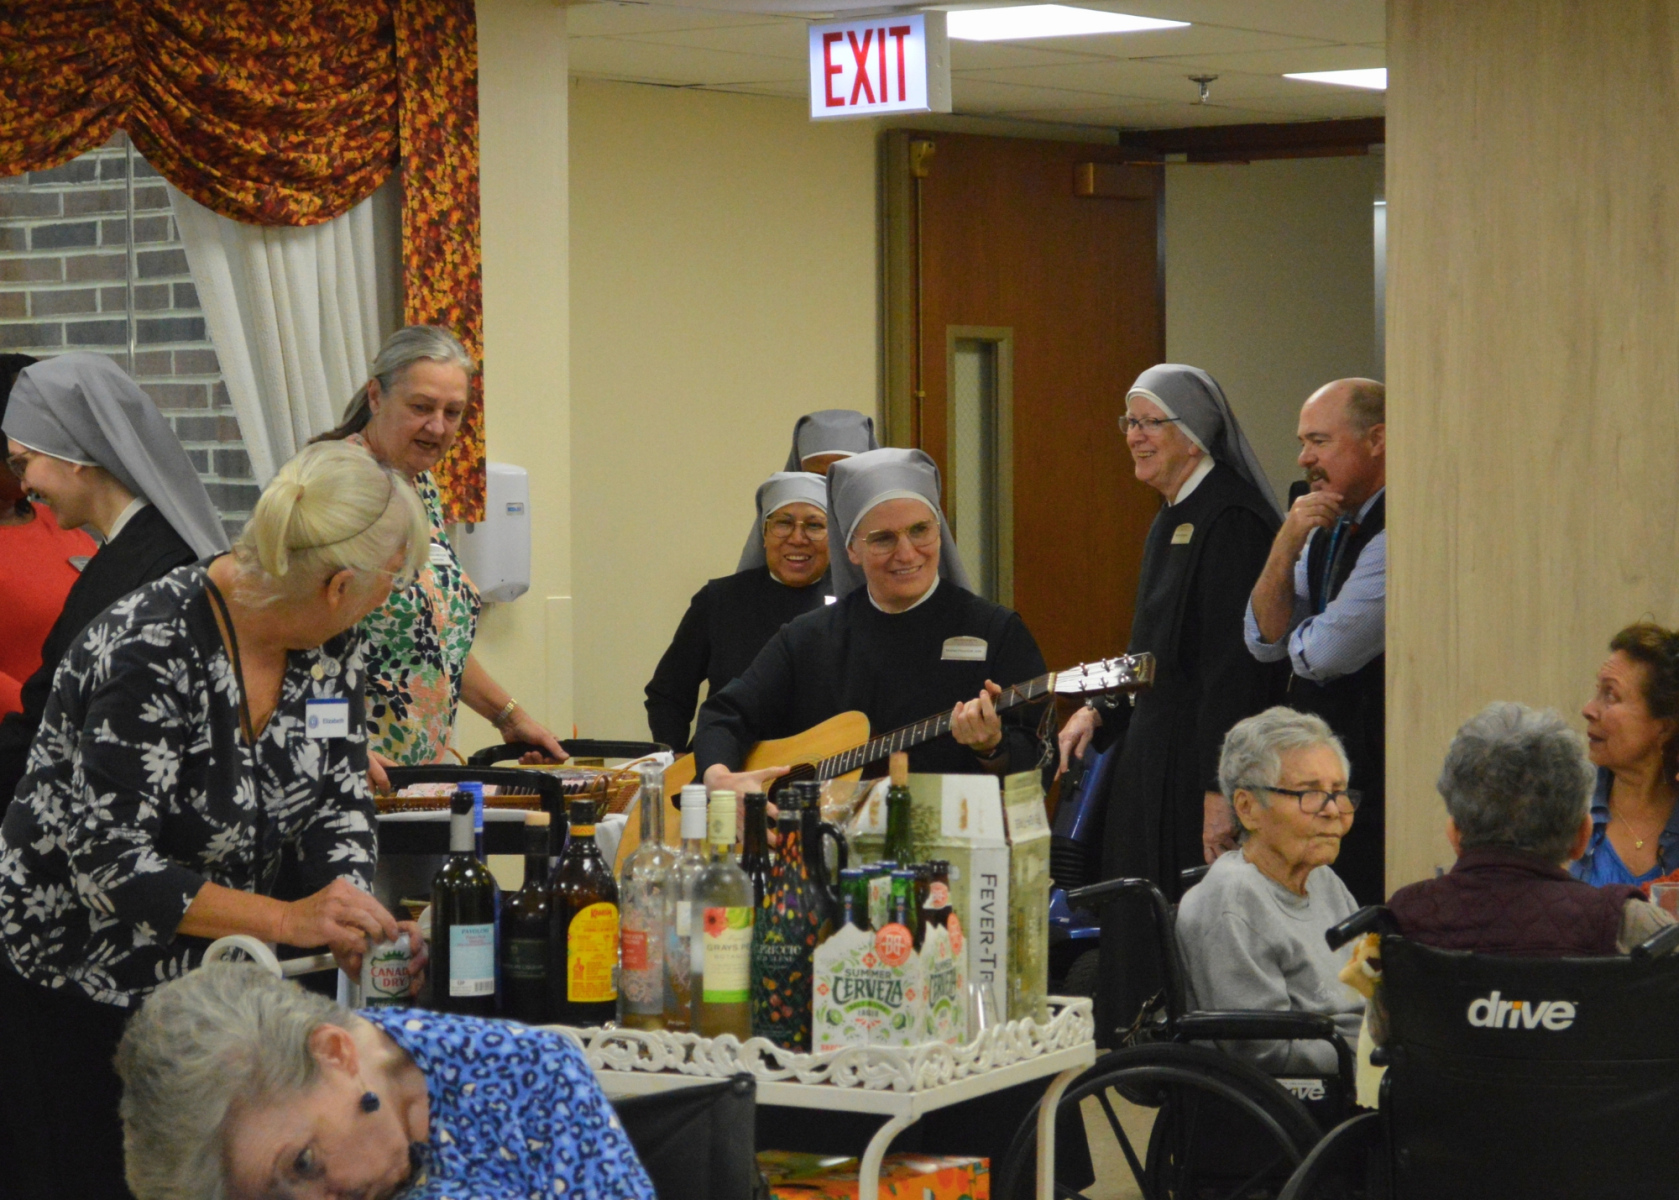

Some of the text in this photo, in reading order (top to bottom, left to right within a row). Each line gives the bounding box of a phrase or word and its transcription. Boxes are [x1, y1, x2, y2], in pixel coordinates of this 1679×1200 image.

[823, 25, 911, 107] EXIT
[706, 943, 738, 951] GRAYS
[370, 966, 409, 978] CANAD
[844, 968, 892, 979] SUMMER
[382, 978, 405, 987] DRY
[832, 975, 903, 1008] CERVEZA
[1467, 990, 1576, 1031] drive
